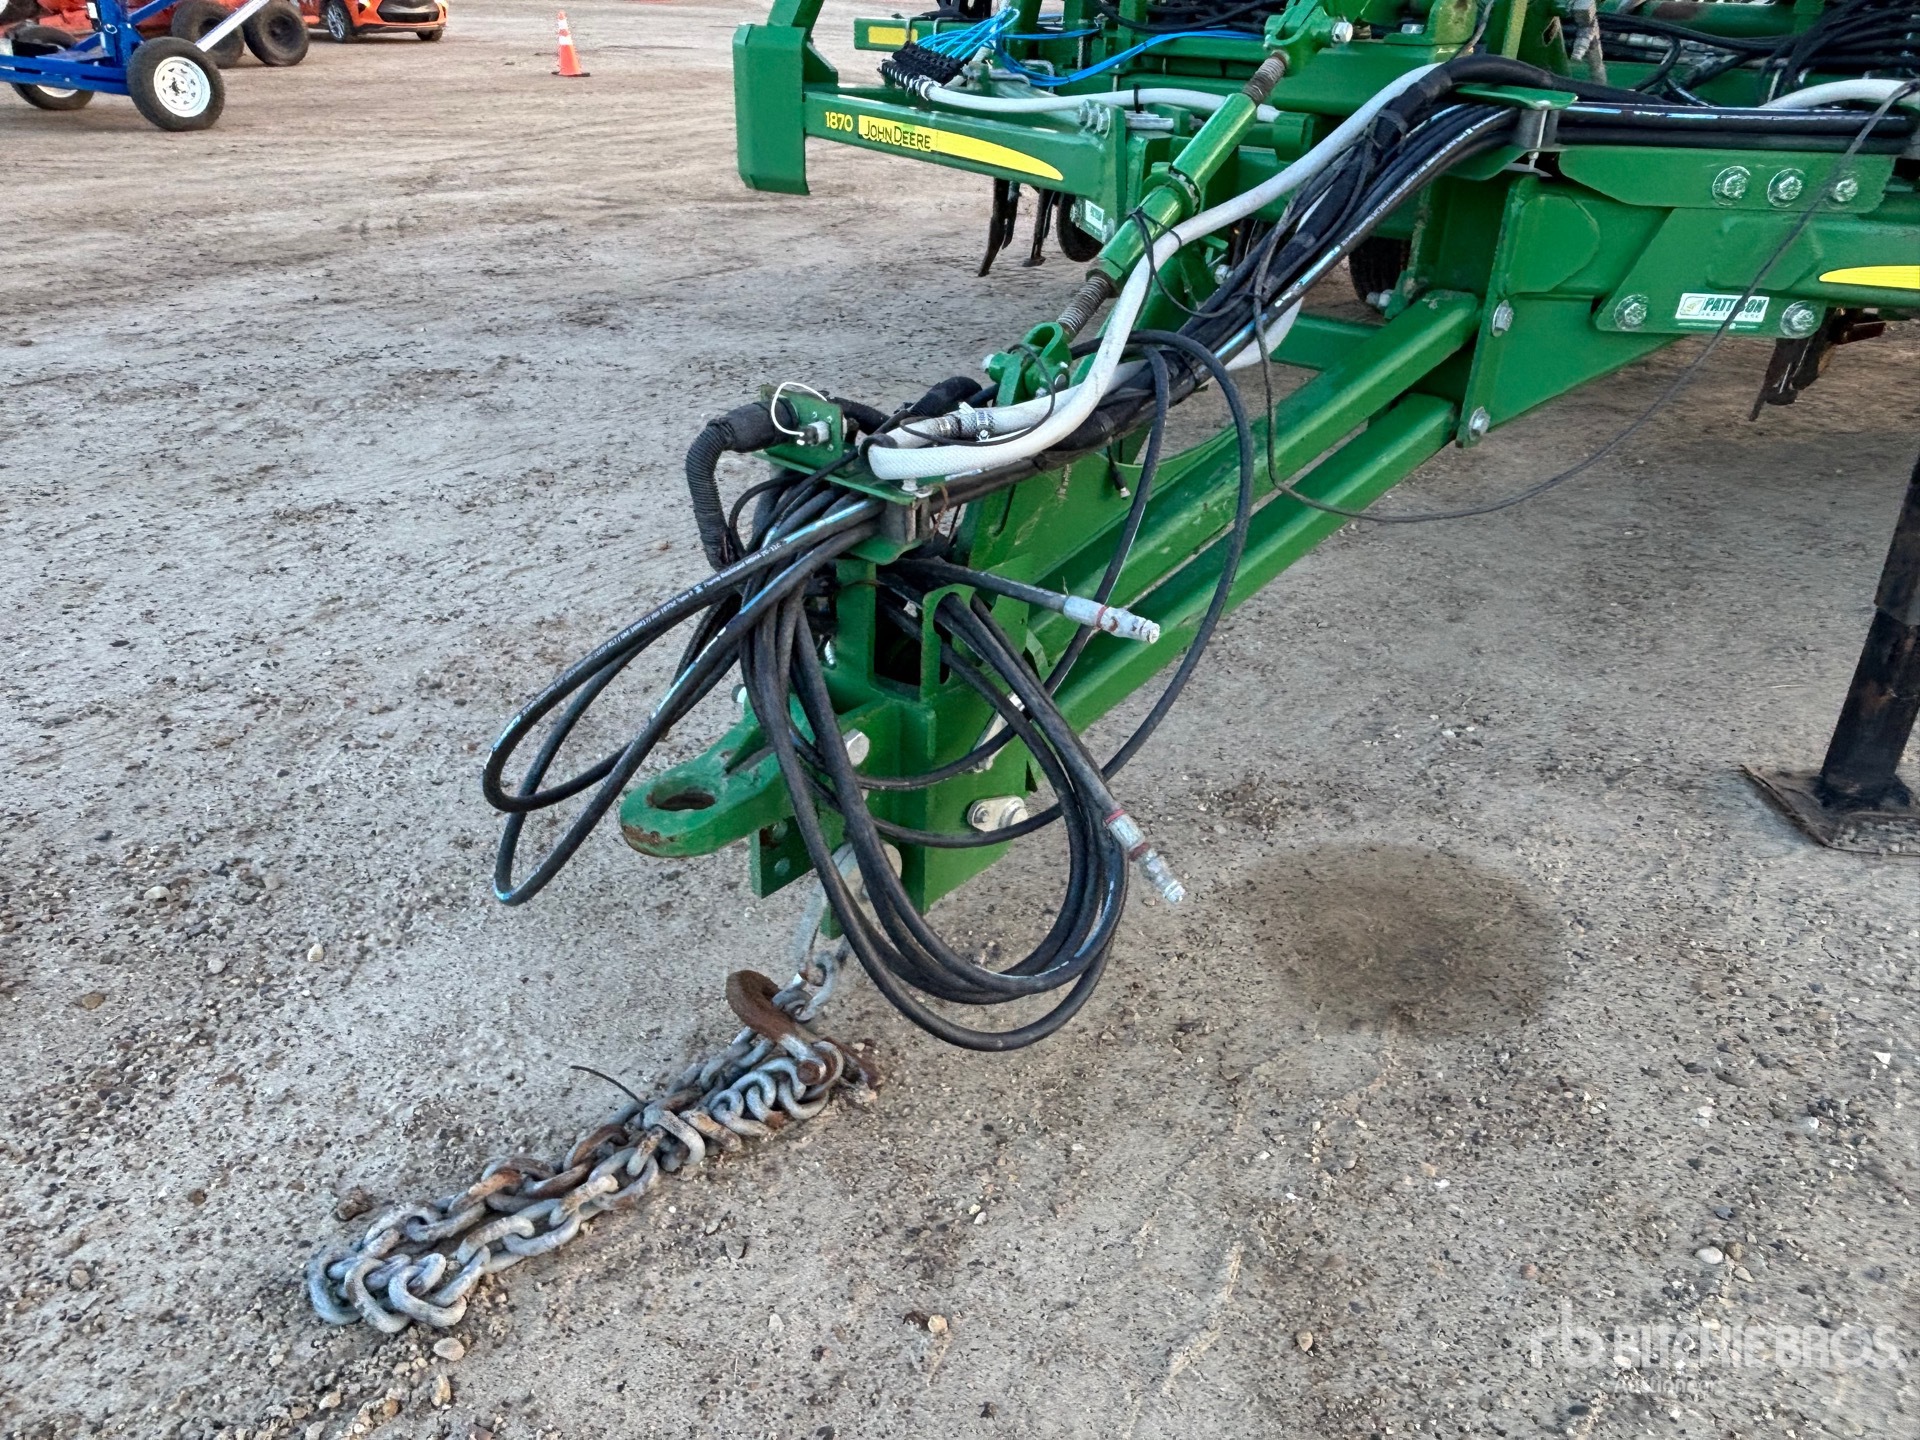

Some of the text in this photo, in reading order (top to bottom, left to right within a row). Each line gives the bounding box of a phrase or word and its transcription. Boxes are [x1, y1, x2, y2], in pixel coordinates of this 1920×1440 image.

[825, 111, 853, 132] 1870
[864, 120, 932, 150] JOHN DEERE
[1703, 297, 1767, 313] PATTON
